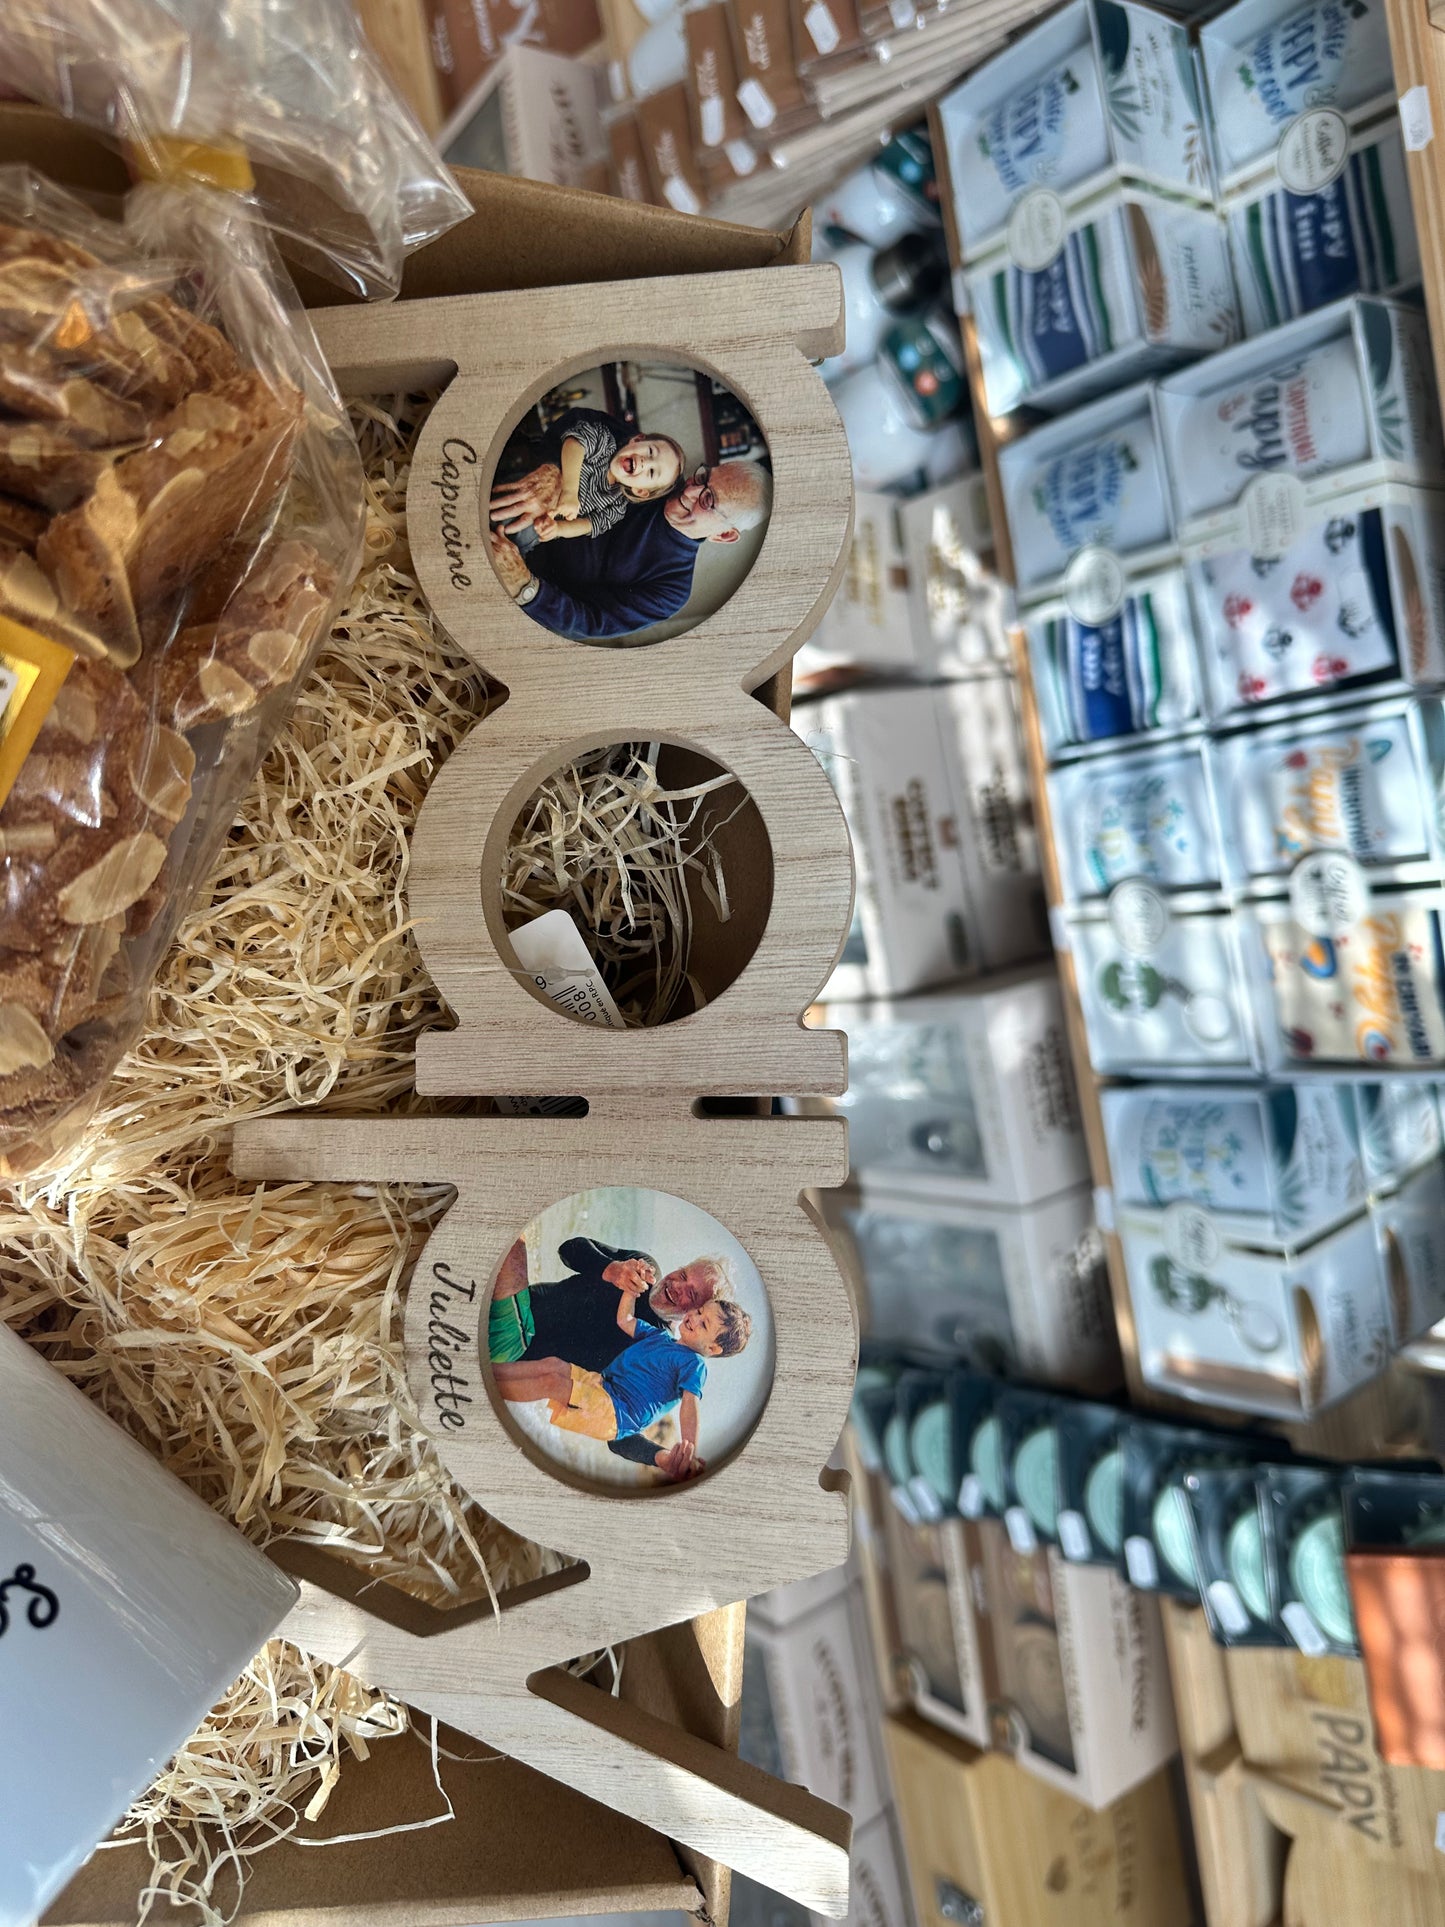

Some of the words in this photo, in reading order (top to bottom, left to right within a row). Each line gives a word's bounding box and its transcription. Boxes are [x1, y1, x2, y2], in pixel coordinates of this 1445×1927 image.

[431, 438, 477, 591] Capucine
[428, 1262, 476, 1432] Juliette
[1311, 1712, 1383, 1843] PAPY
